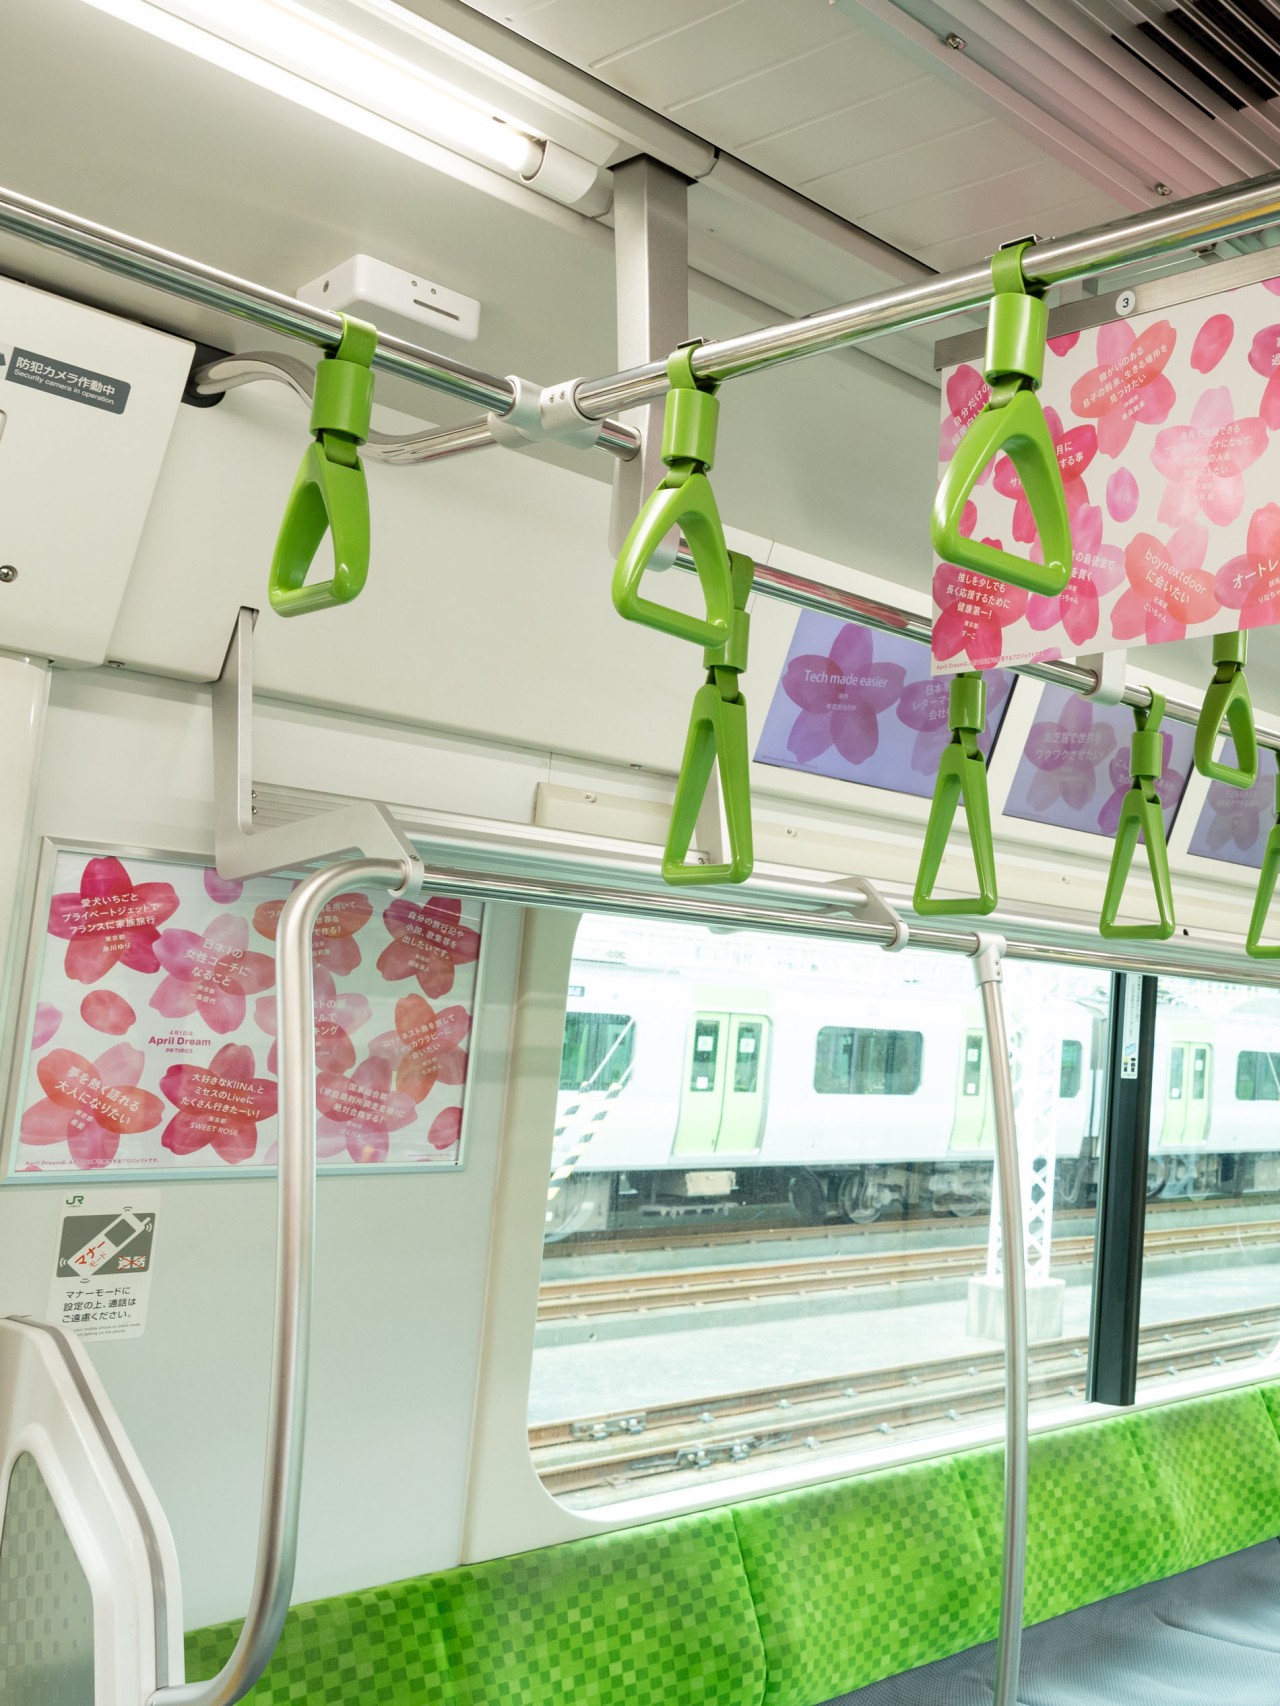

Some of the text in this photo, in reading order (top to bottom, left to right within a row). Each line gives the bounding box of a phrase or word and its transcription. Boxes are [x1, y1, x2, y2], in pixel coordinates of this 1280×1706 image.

[1122, 297, 1130, 309] 3
[13, 368, 45, 384] Security
[44, 378, 72, 392] camera
[81, 389, 115, 405] operation
[16, 356, 116, 396] 防犯カメラ作動中
[1109, 373, 1147, 405] 見つけたい
[1144, 547, 1206, 594] boynextdoor
[957, 572, 1006, 593] 推しを少しでも
[1146, 570, 1190, 604] に会いたい
[946, 584, 1010, 609] 長く応援するために
[961, 630, 977, 640] すーこ
[964, 620, 979, 631] 東京都
[804, 669, 889, 688] Tech made easier
[81, 893, 139, 908] 愛犬いちごと
[62, 902, 161, 922] プライベートジェットで
[70, 915, 155, 935] フランスに家族旅行
[408, 911, 464, 938] 自分の旅行記や
[105, 933, 126, 942] 東京都
[405, 923, 457, 949] 小説、歌集等を
[203, 938, 243, 959] 日本1の
[402, 935, 450, 959] 出したいです。
[184, 948, 252, 977] 女性コーチに
[192, 966, 231, 987] なること
[149, 1036, 211, 1046] April Dream
[411, 1043, 441, 1060] 会いたい
[66, 1066, 140, 1112] 夢を熱く語れる
[192, 1073, 264, 1095] 大好きなKIINA.と
[55, 1080, 131, 1124] 大人になりたい
[195, 1086, 255, 1105] ミセスのLiveに
[190, 1122, 239, 1137] SWEET ROSE
[66, 1196, 84, 1205] JR
[74, 1241, 106, 1265] マナー
[65, 1286, 131, 1299] マナーモードに
[63, 1298, 137, 1312] 設定の上、通話は
[62, 1311, 132, 1323] ご遠慮ください。
